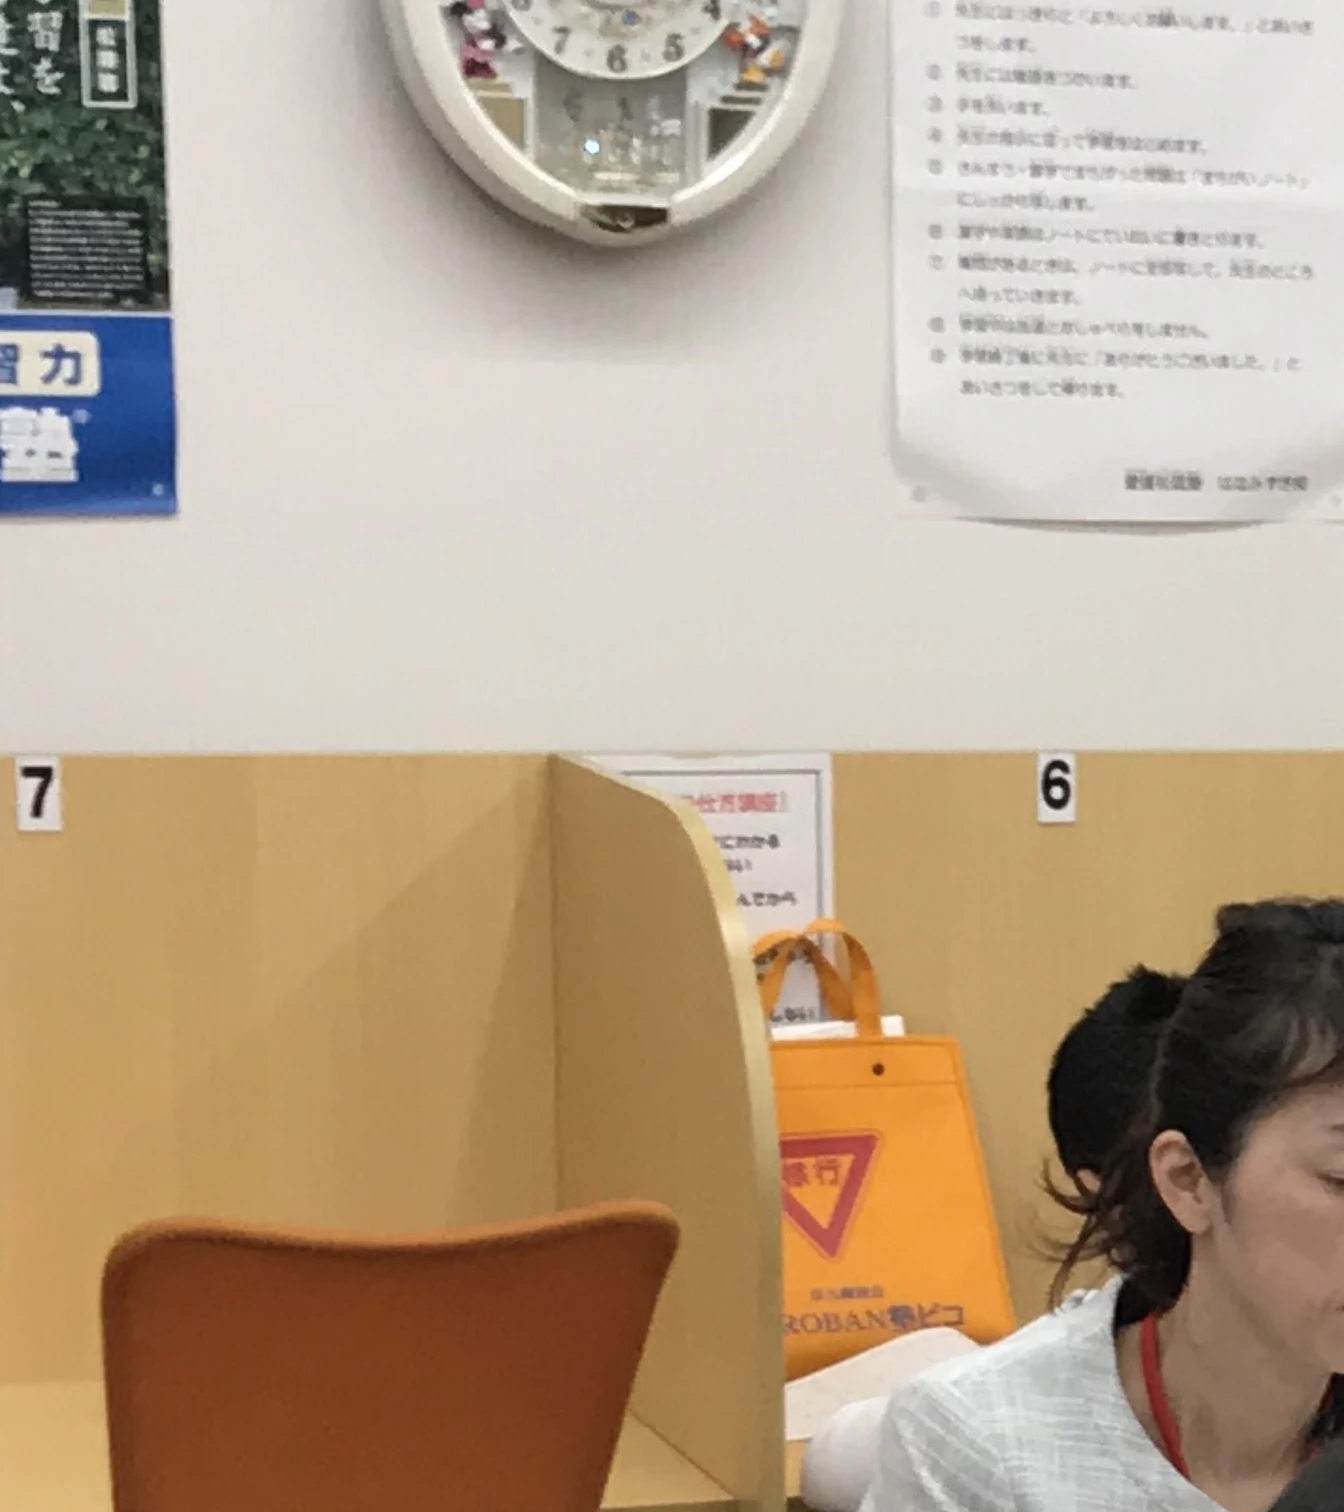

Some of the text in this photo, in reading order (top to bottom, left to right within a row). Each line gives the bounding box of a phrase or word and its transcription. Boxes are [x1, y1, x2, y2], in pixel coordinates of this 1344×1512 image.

[551, 26, 572, 54] 7
[662, 33, 686, 62] 5
[606, 44, 627, 73] 6
[20, 766, 55, 818] 7
[1041, 759, 1071, 811] 6
